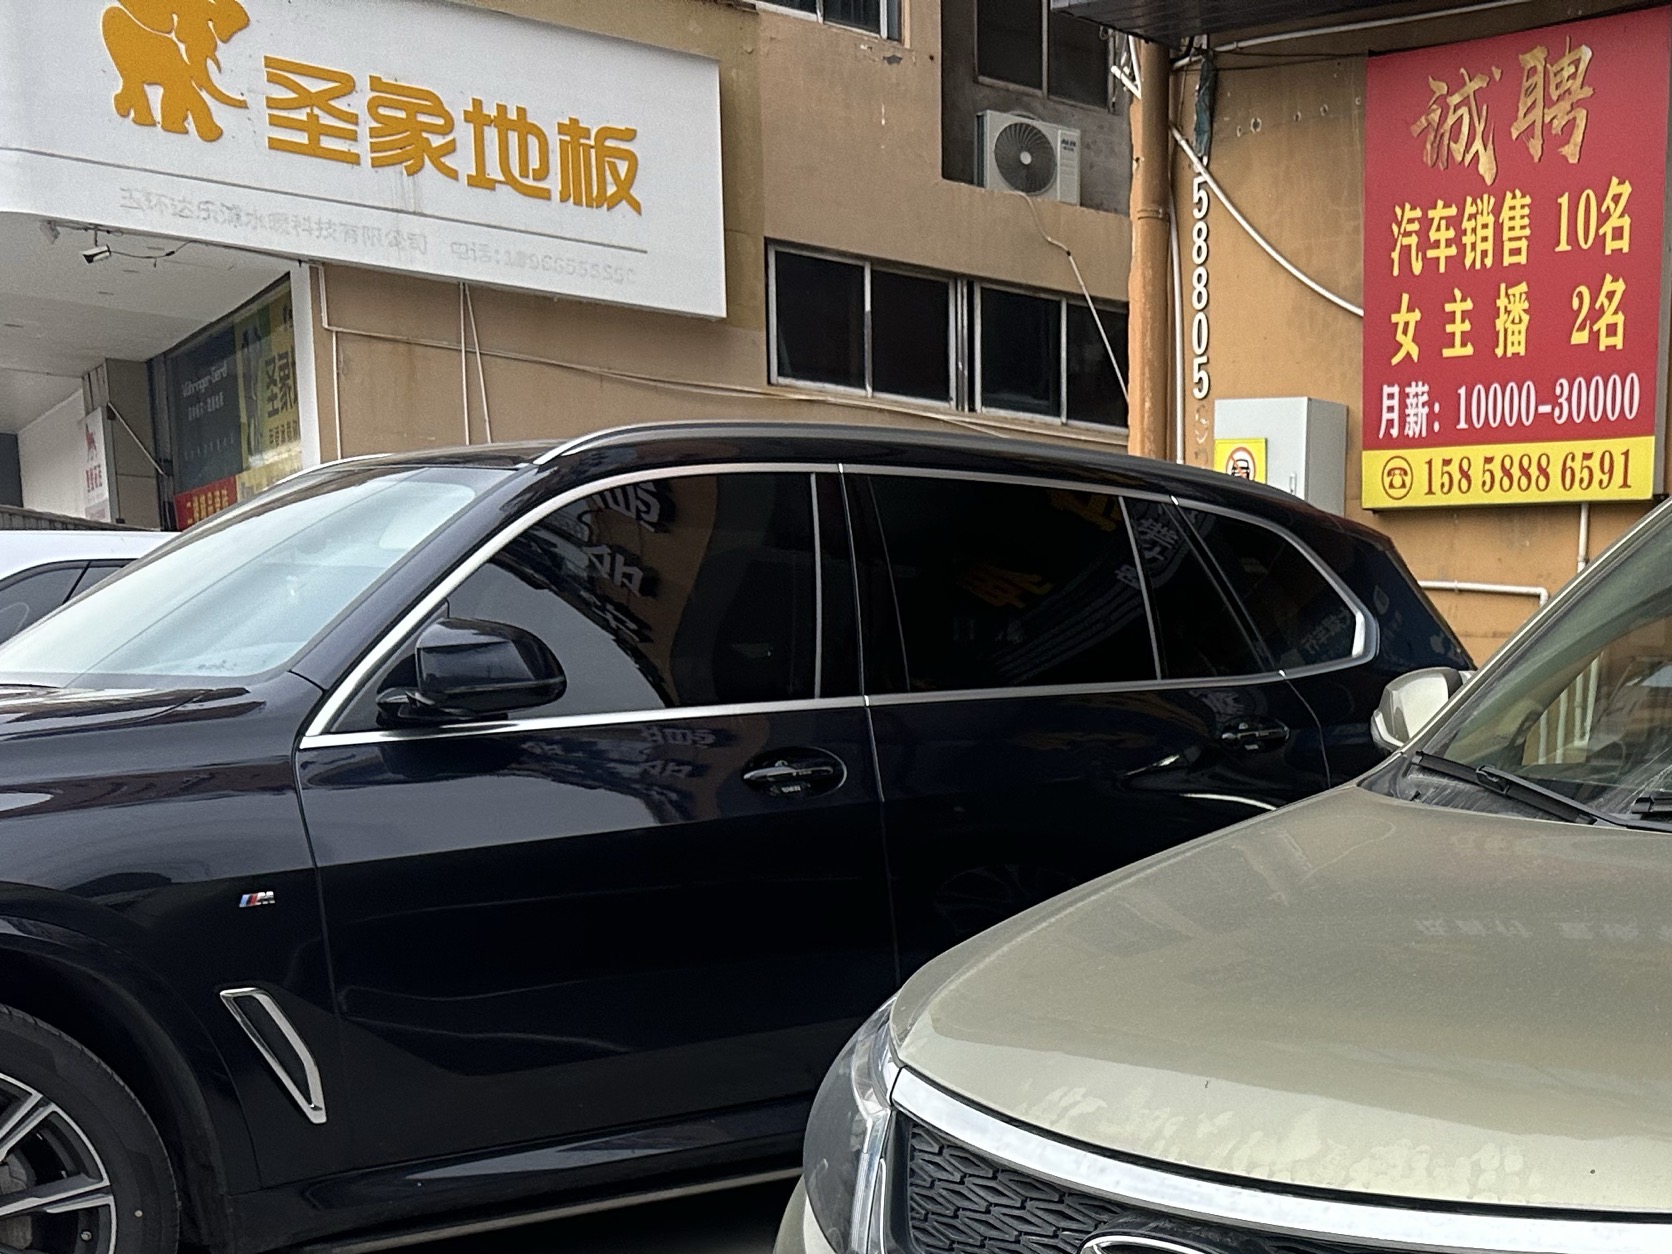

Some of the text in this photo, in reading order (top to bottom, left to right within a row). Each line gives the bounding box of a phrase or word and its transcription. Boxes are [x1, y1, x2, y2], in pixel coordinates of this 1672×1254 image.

[263, 55, 643, 217] 圣象地板
[1410, 36, 1596, 184] 诚聘
[1391, 176, 1632, 277] 汽车销售 10名
[1571, 273, 1626, 351] 2名
[1378, 372, 1640, 439] 月薪: 10000-30000
[1423, 449, 1632, 496] 158 5888 6591
